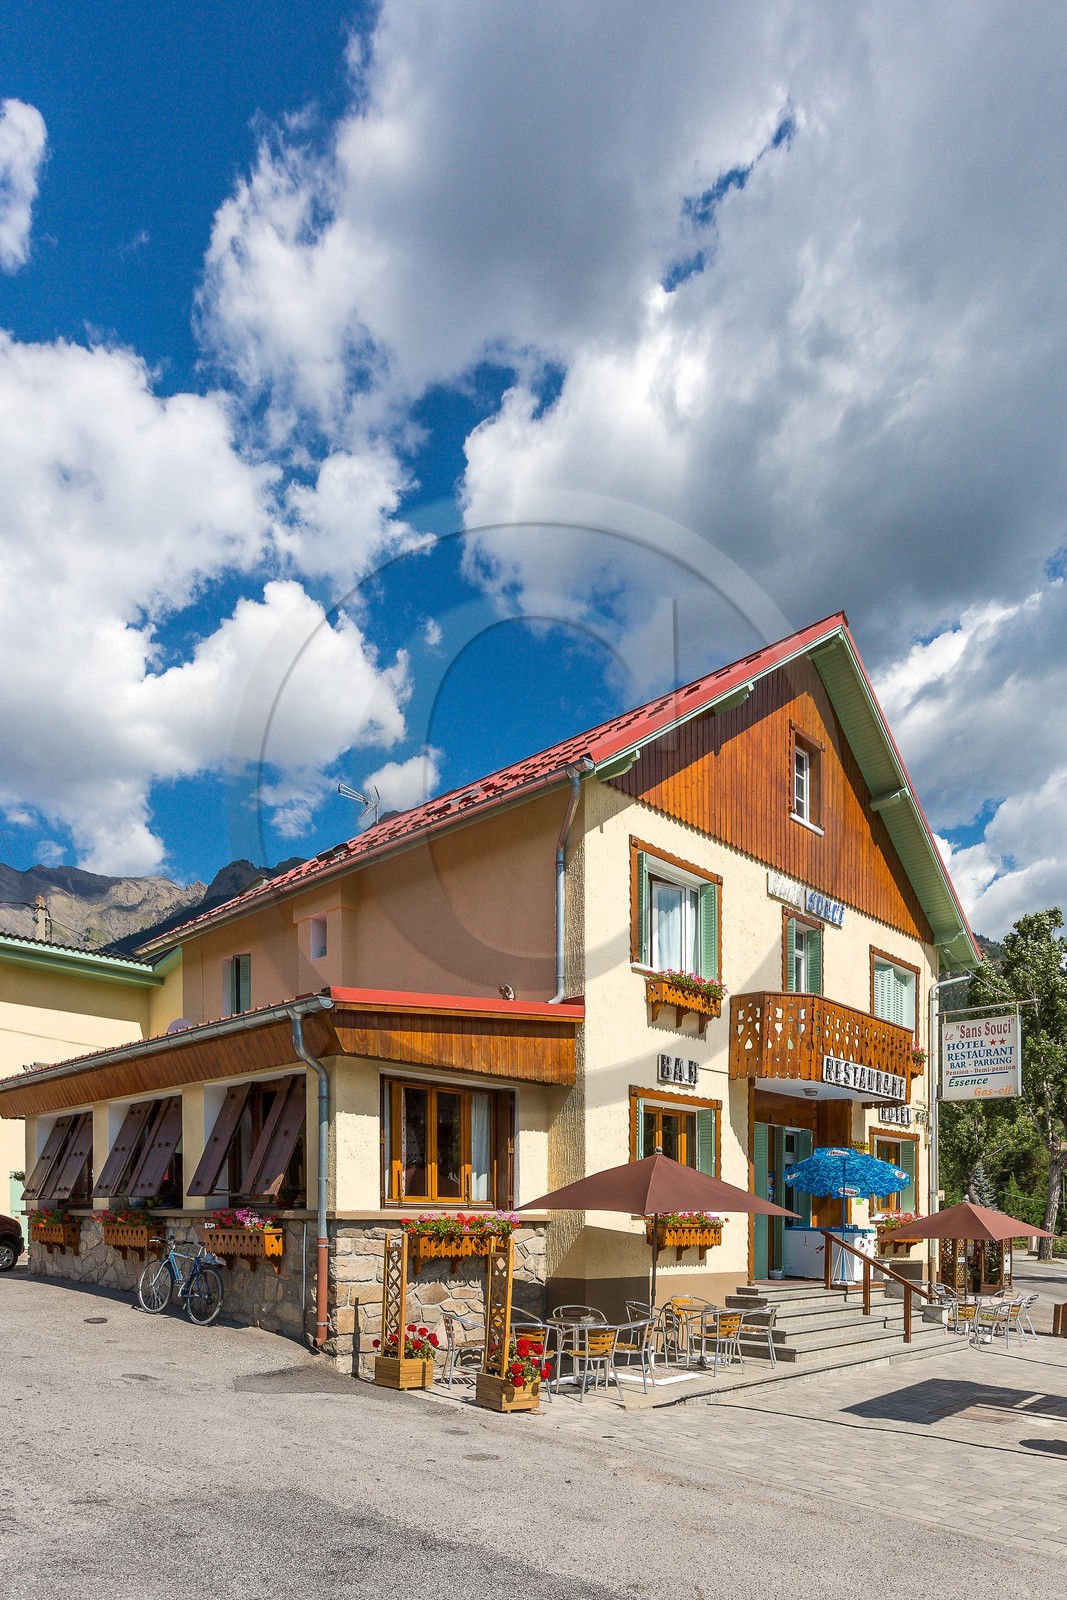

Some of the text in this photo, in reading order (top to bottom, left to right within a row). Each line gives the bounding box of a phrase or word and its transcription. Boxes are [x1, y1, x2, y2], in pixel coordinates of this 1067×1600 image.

[944, 1032, 954, 1041] Le
[946, 1040, 987, 1051] HÔTEL
[947, 1046, 1015, 1061] RESTAURANT
[973, 1057, 1012, 1067] PARKING
[660, 1054, 699, 1084] BAR
[974, 1065, 1016, 1074] Demi-pension
[948, 1077, 989, 1088] Essence
[973, 1084, 1013, 1097] Gas-oil
